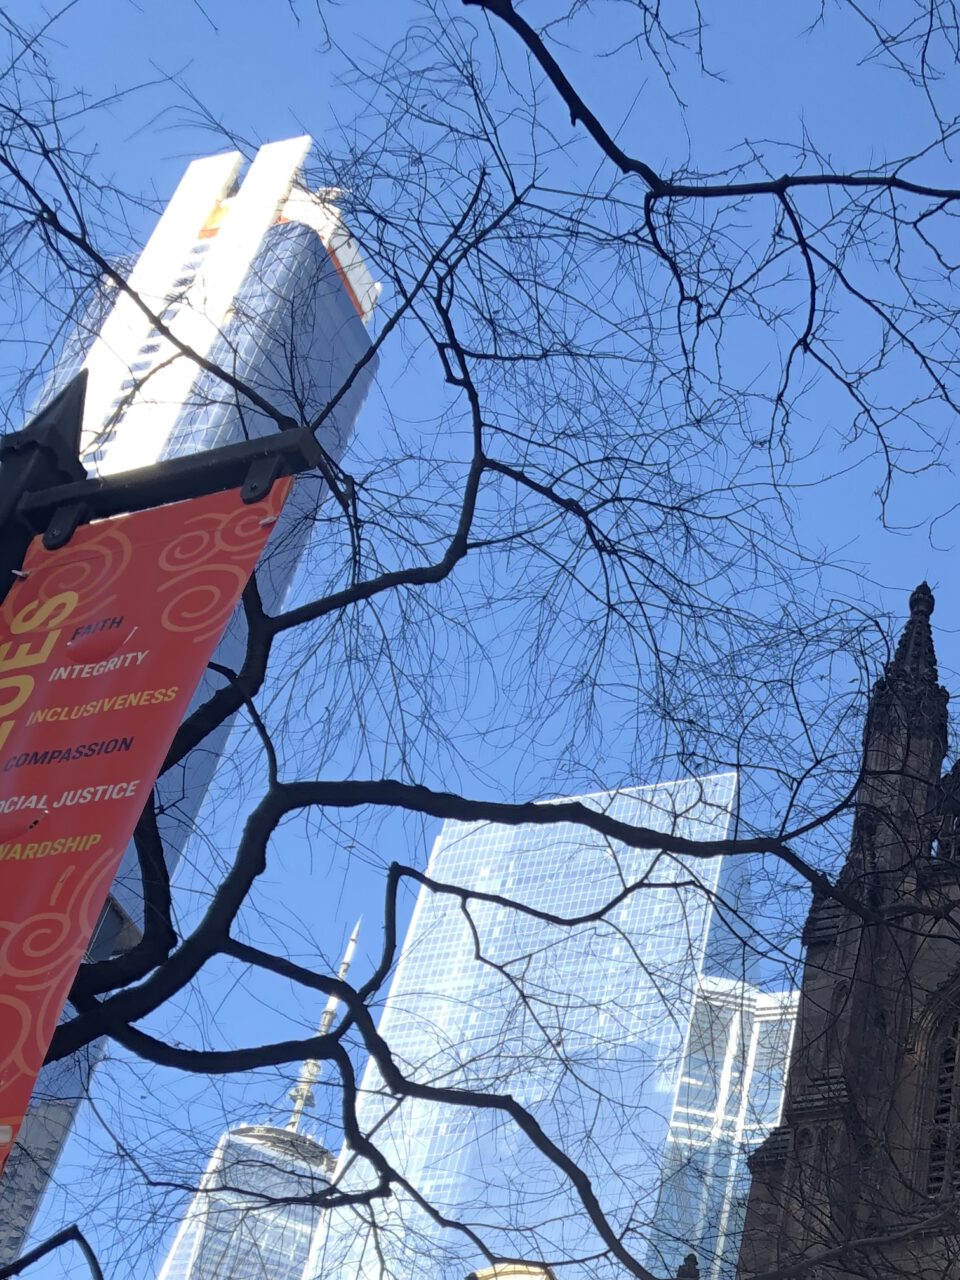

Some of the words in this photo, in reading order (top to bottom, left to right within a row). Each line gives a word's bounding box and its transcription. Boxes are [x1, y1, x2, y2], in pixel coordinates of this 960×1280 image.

[71, 616, 124, 641] FAITH
[0, 590, 79, 750] UES
[48, 650, 149, 682] INTEGRITY
[26, 686, 178, 727] INCLUSIVENESS
[4, 737, 135, 772] COMPASSION
[52, 780, 141, 808] JUSTICE
